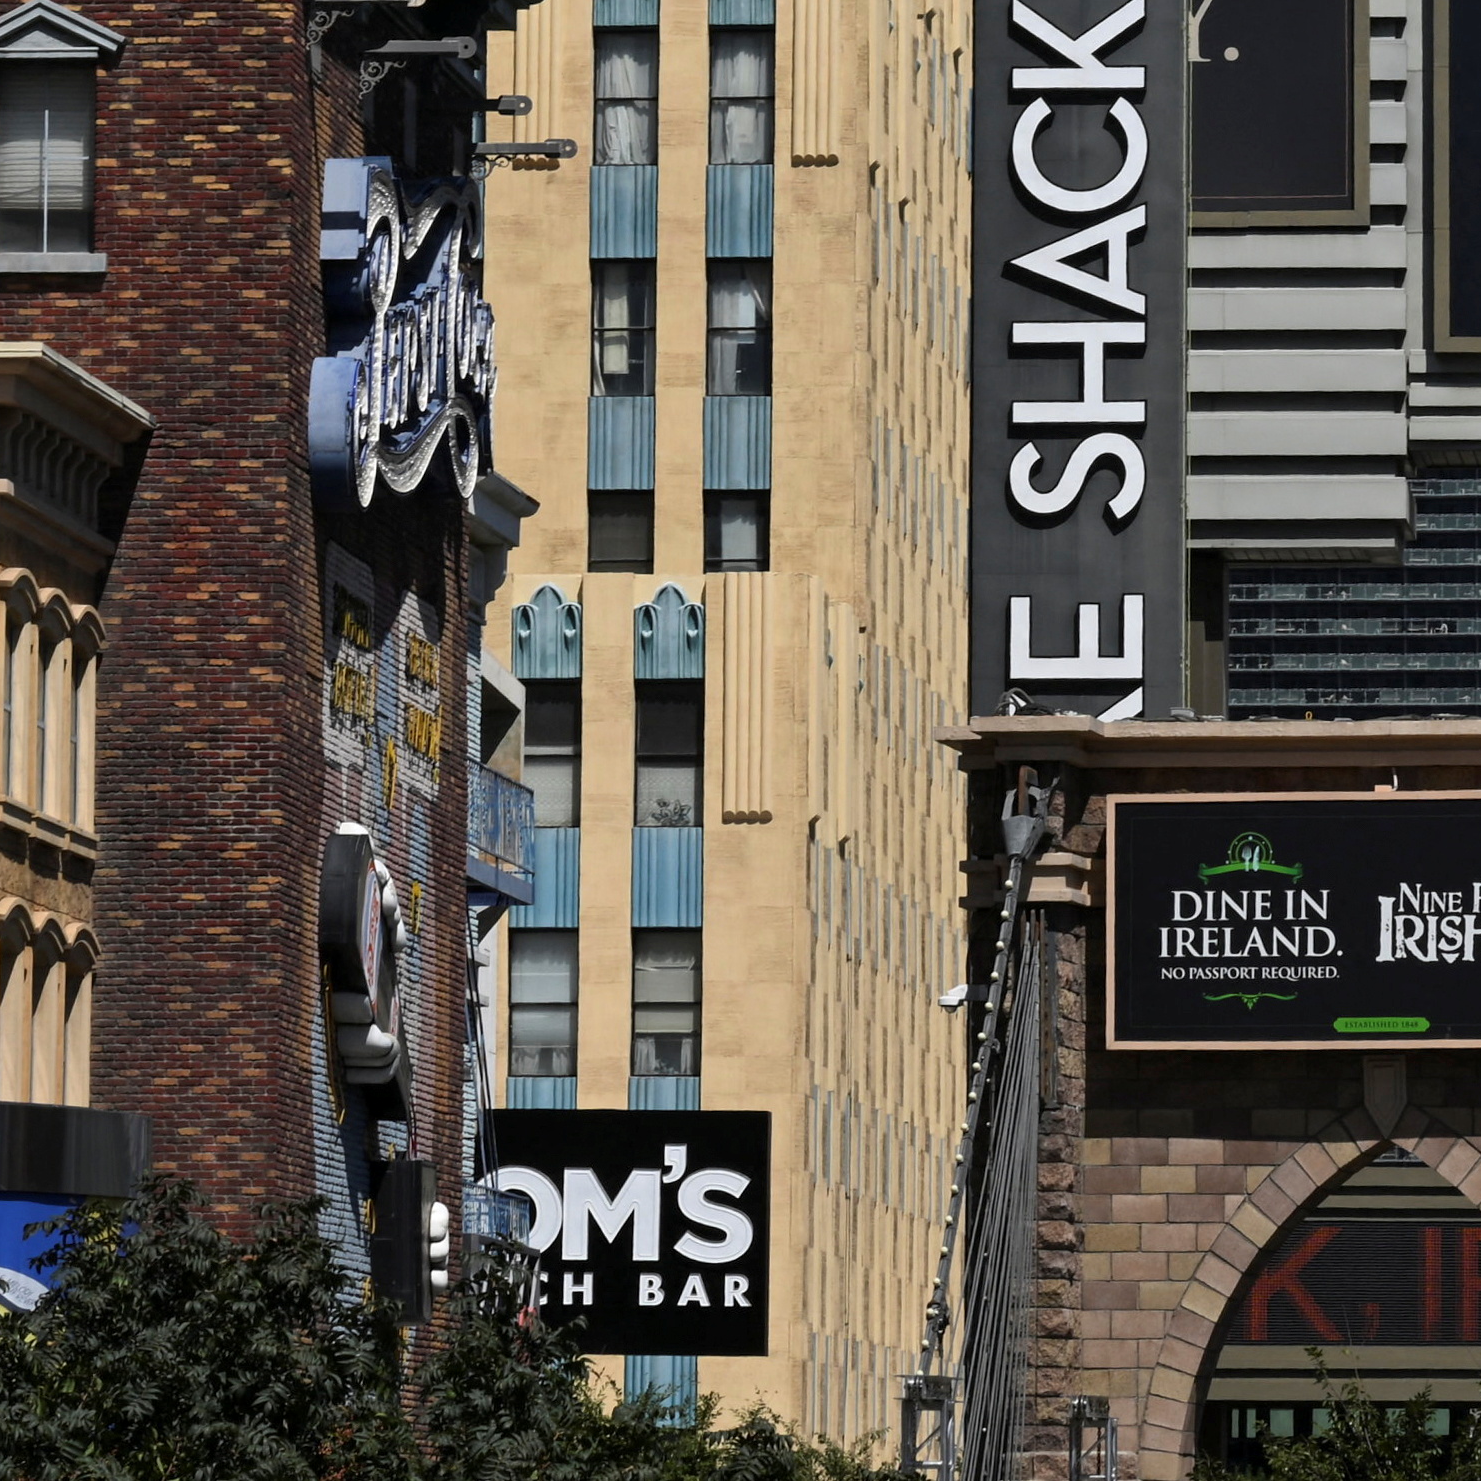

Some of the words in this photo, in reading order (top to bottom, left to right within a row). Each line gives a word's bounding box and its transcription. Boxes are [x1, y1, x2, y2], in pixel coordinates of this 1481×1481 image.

[1009, 592, 1146, 721] E
[1170, 889, 1273, 922] DINE
[1283, 889, 1331, 921] IN
[1158, 925, 1344, 959] IRELAND.
[1160, 967, 1186, 980] NO
[1188, 966, 1259, 980] PASSPORT
[1261, 966, 1340, 981] REQUIRED.
[638, 1272, 753, 1307] BAR
